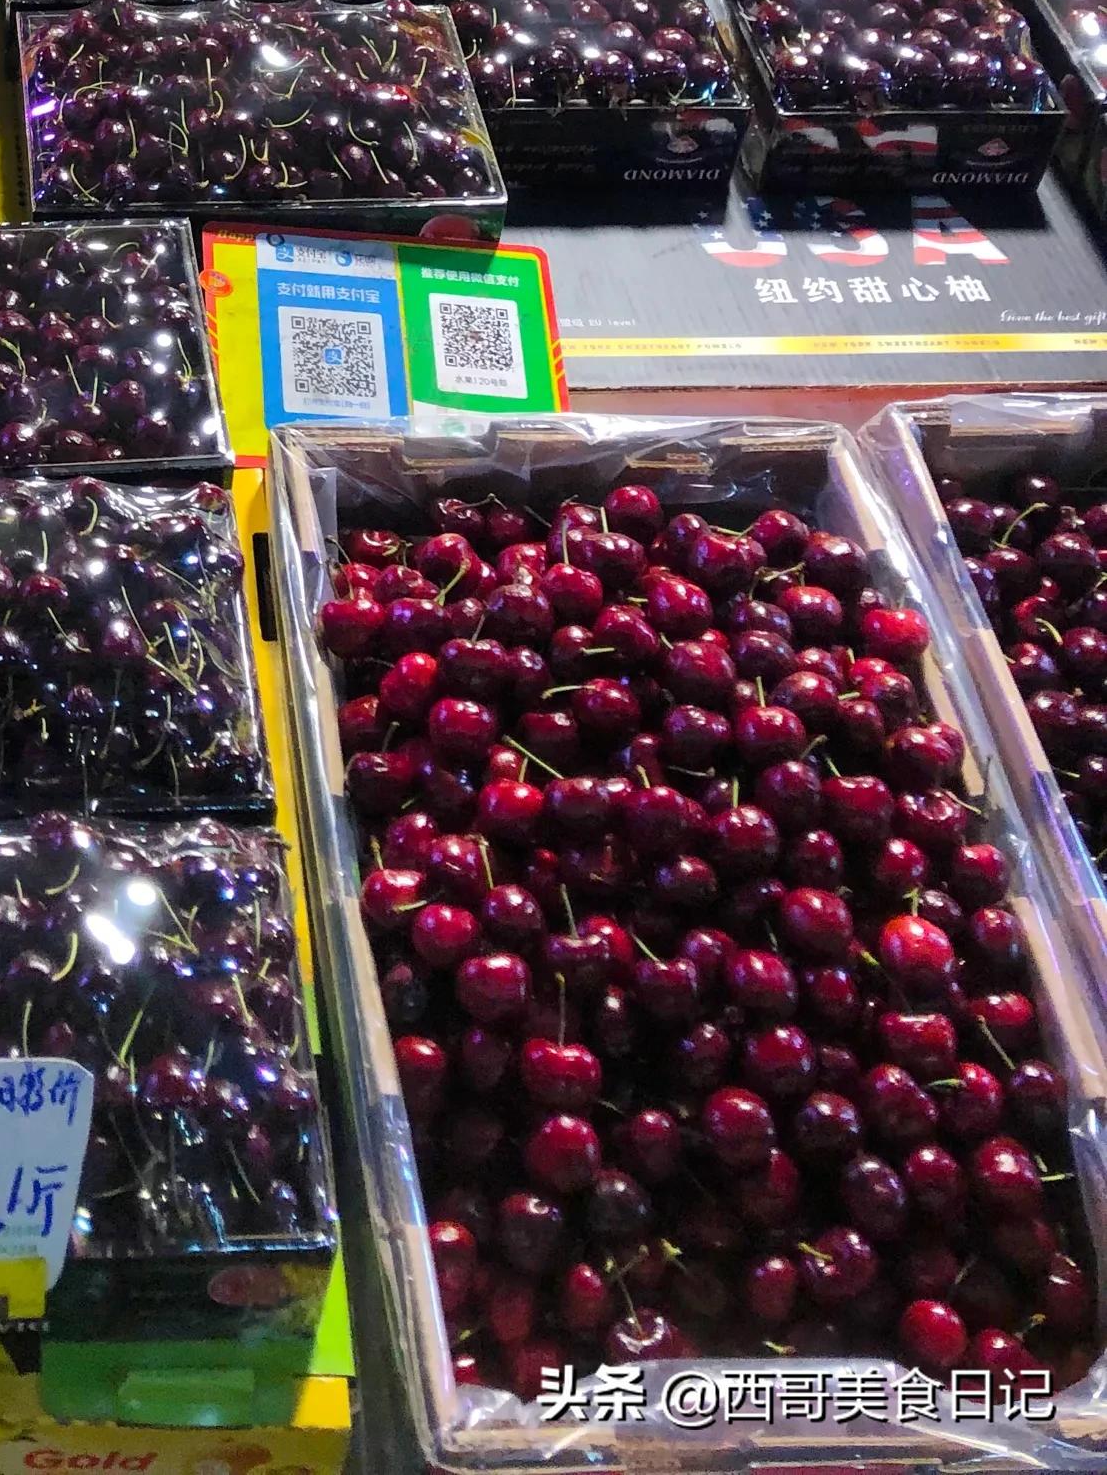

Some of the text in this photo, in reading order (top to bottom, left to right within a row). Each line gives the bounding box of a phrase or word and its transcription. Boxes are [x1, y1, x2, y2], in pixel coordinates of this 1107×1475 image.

[420, 267, 520, 288] 推荐使用微信支付
[276, 281, 382, 304] 支付就用支付宝
[753, 275, 992, 305] 纽约甜心柚
[23, 1447, 158, 1471] Gold
